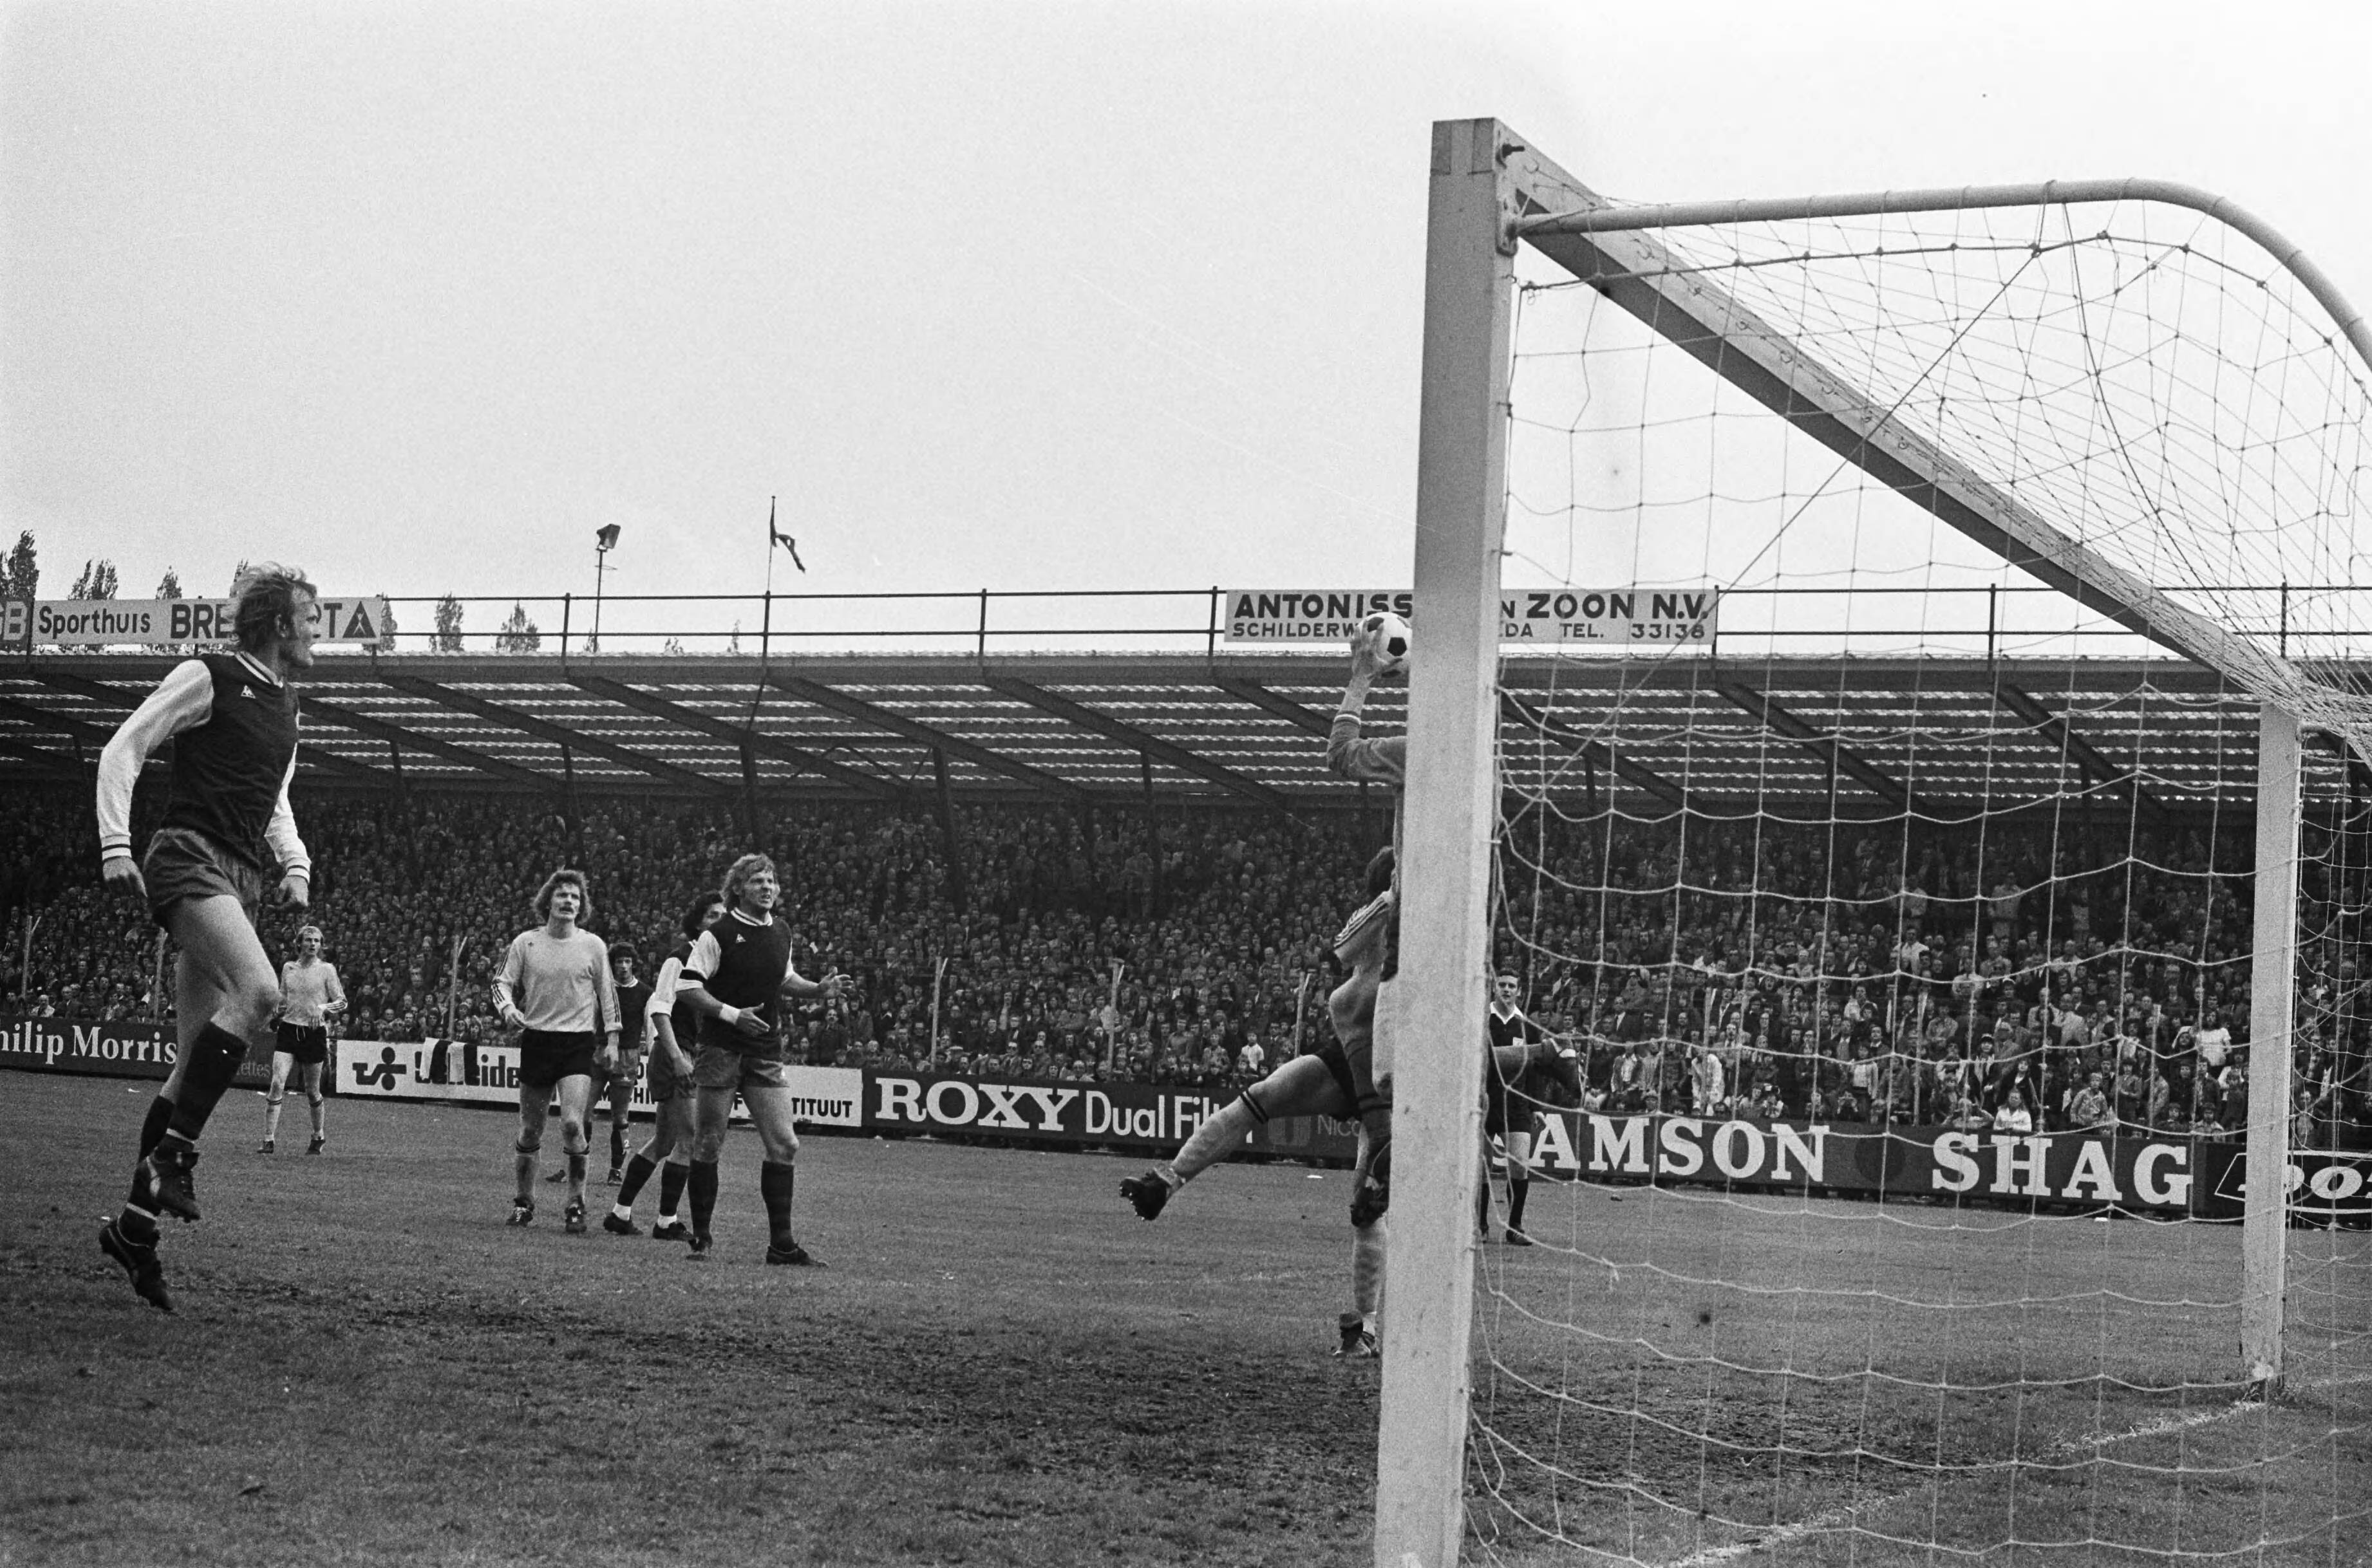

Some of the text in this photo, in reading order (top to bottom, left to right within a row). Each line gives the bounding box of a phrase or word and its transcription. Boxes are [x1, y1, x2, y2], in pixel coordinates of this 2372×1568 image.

[38, 605, 151, 639] Sporthuis
[1234, 593, 1413, 619] ANTONISS
[1527, 593, 1634, 619] ZOON
[1559, 622, 1605, 639] TEL.
[1631, 623, 1706, 639] 33138
[71, 1025, 177, 1064] Morris
[791, 1097, 853, 1118] TITUUT
[875, 1076, 1079, 1132] ROXY
[1086, 1090, 1165, 1139] Dual
[1492, 1114, 1830, 1182] AMSON
[1931, 1131, 2194, 1206] SHAG
